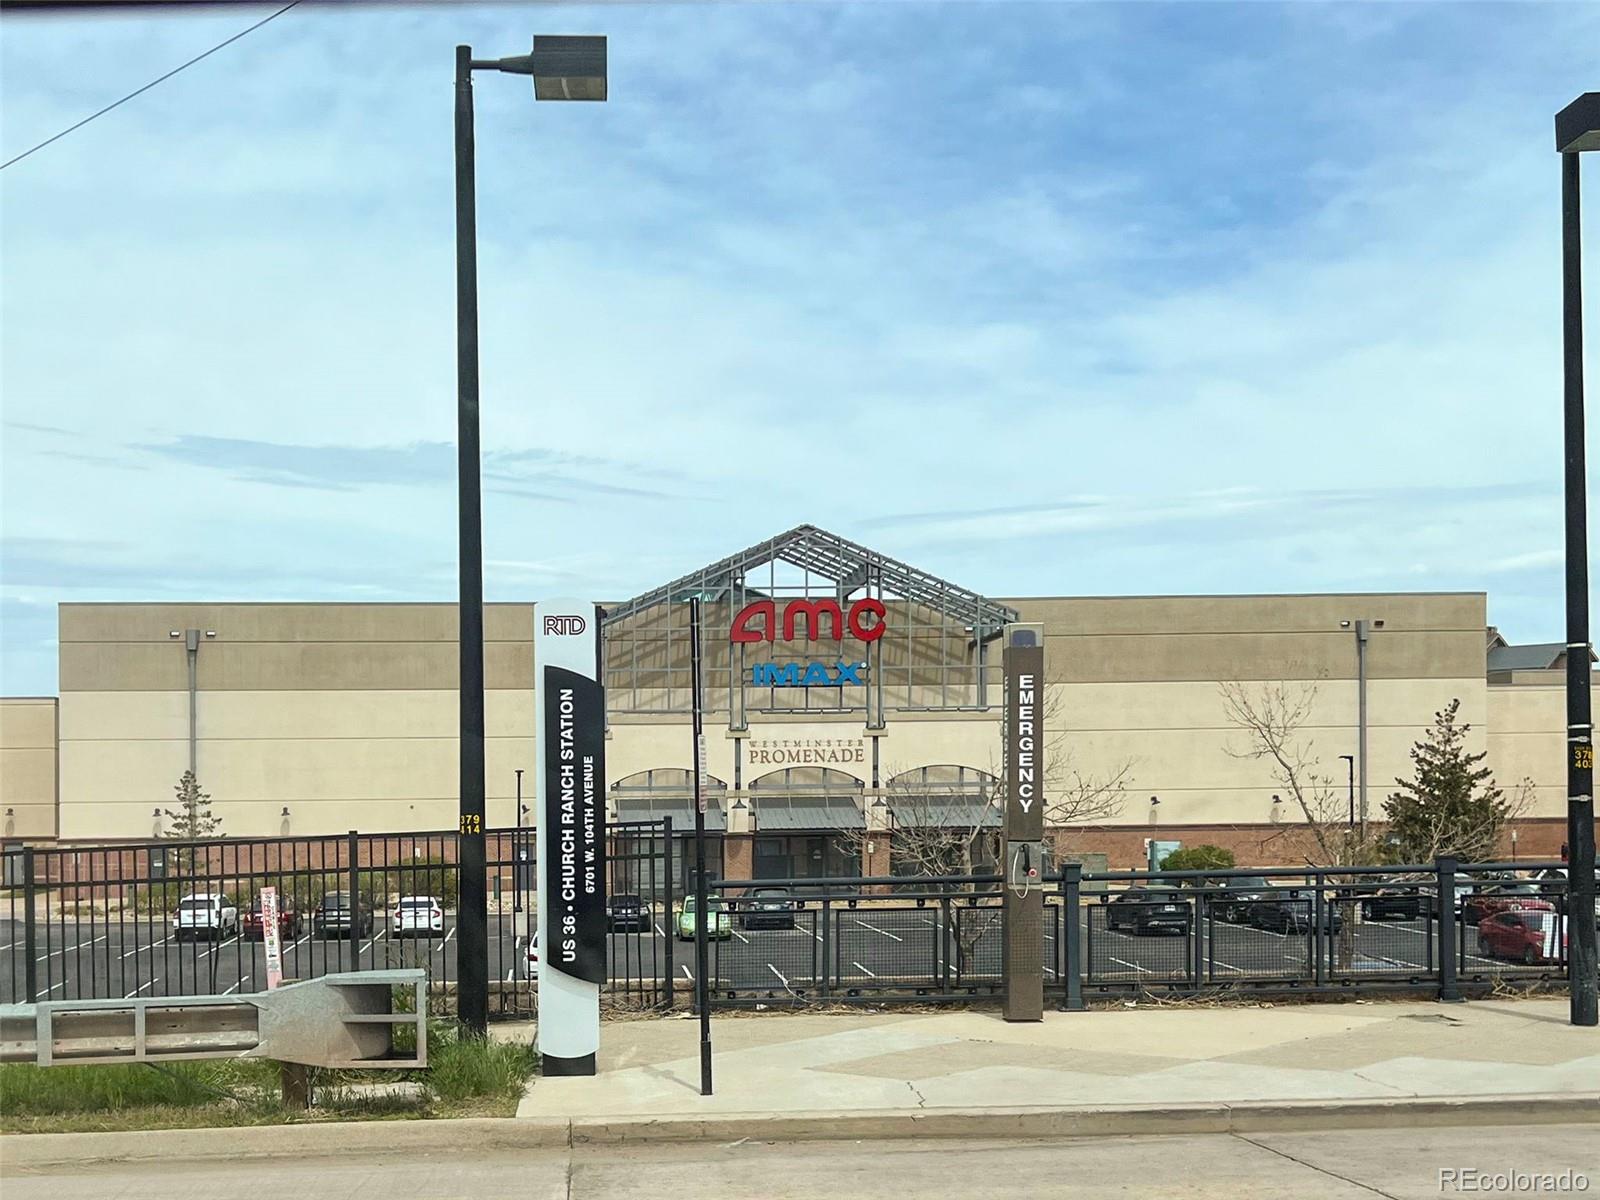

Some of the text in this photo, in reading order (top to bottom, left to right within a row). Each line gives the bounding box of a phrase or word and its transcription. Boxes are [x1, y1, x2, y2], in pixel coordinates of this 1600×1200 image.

[543, 615, 586, 636] RTD
[752, 662, 863, 687] IMAX
[748, 739, 864, 748] WESTMINSTER
[749, 748, 865, 764] PROMENADE
[1018, 674, 1035, 814] EMERGENCY
[560, 688, 576, 963] US 36 CHURCH RANCH STATION
[583, 755, 595, 893] 6701 W. 104TH AVENUE
